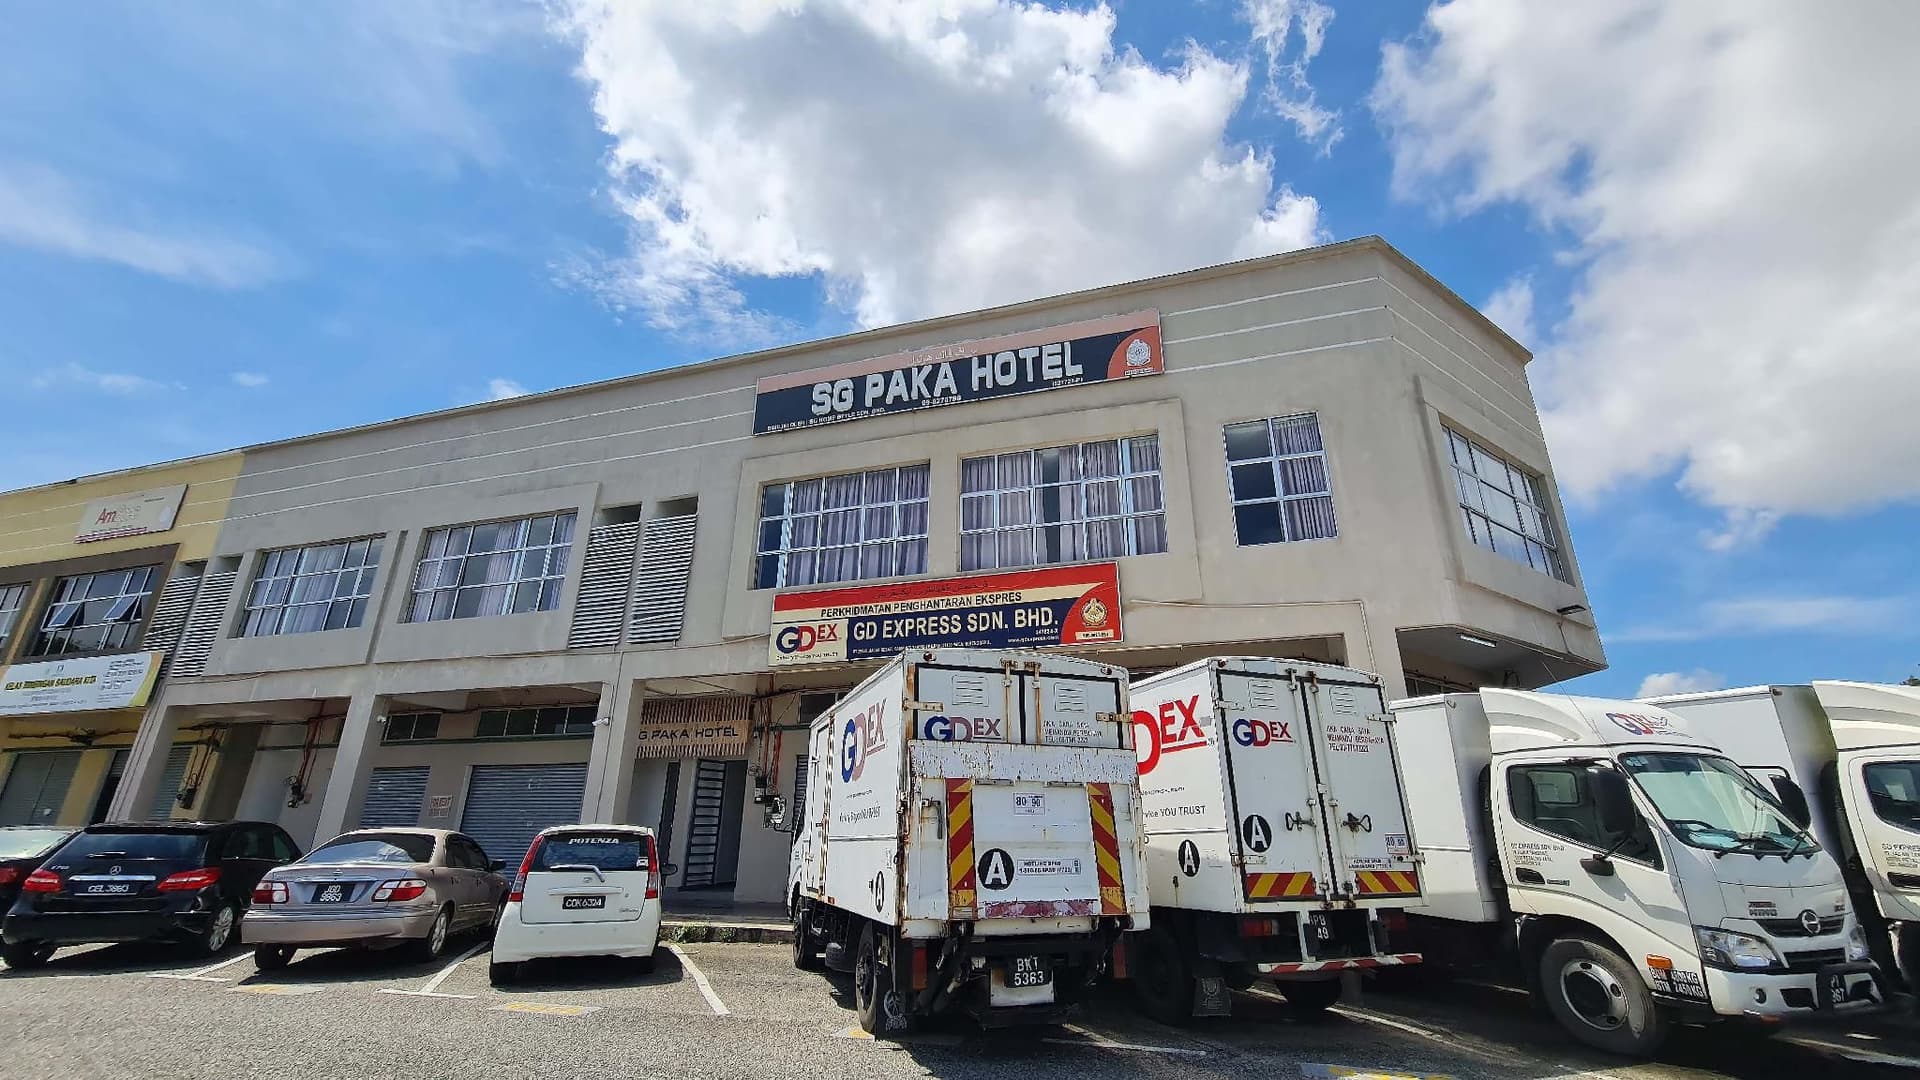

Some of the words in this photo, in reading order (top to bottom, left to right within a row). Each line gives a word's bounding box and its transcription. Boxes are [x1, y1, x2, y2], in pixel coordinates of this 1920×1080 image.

[811, 378, 854, 416] SG
[864, 361, 958, 408] PAKA
[971, 341, 1084, 392] HOTEL
[820, 603, 892, 618] PERKHIDMATAN
[893, 596, 972, 612] PENGHANTARAN
[975, 591, 1022, 606] EKSPRES
[775, 623, 838, 654] GDEX
[853, 621, 877, 641] GD
[882, 615, 962, 639] EXPRESS
[967, 610, 1009, 633] SDN.
[1014, 606, 1059, 628] BHD.
[638, 730, 648, 740] G
[651, 728, 690, 740] PAKA
[695, 725, 739, 738] HOTEL
[841, 698, 887, 784] GDEX
[924, 715, 1001, 742] GDEX
[1130, 694, 1206, 776] DEX
[1232, 718, 1291, 747] GDEX
[1160, 807, 1177, 817] YOU
[1179, 805, 1206, 817] TRUST
[568, 837, 619, 845] POTENZA
[1251, 816, 1269, 849] A
[984, 851, 1008, 885] A
[1183, 841, 1196, 874] A
[1014, 970, 1044, 986] 5363
[1016, 956, 1038, 972] BKT
